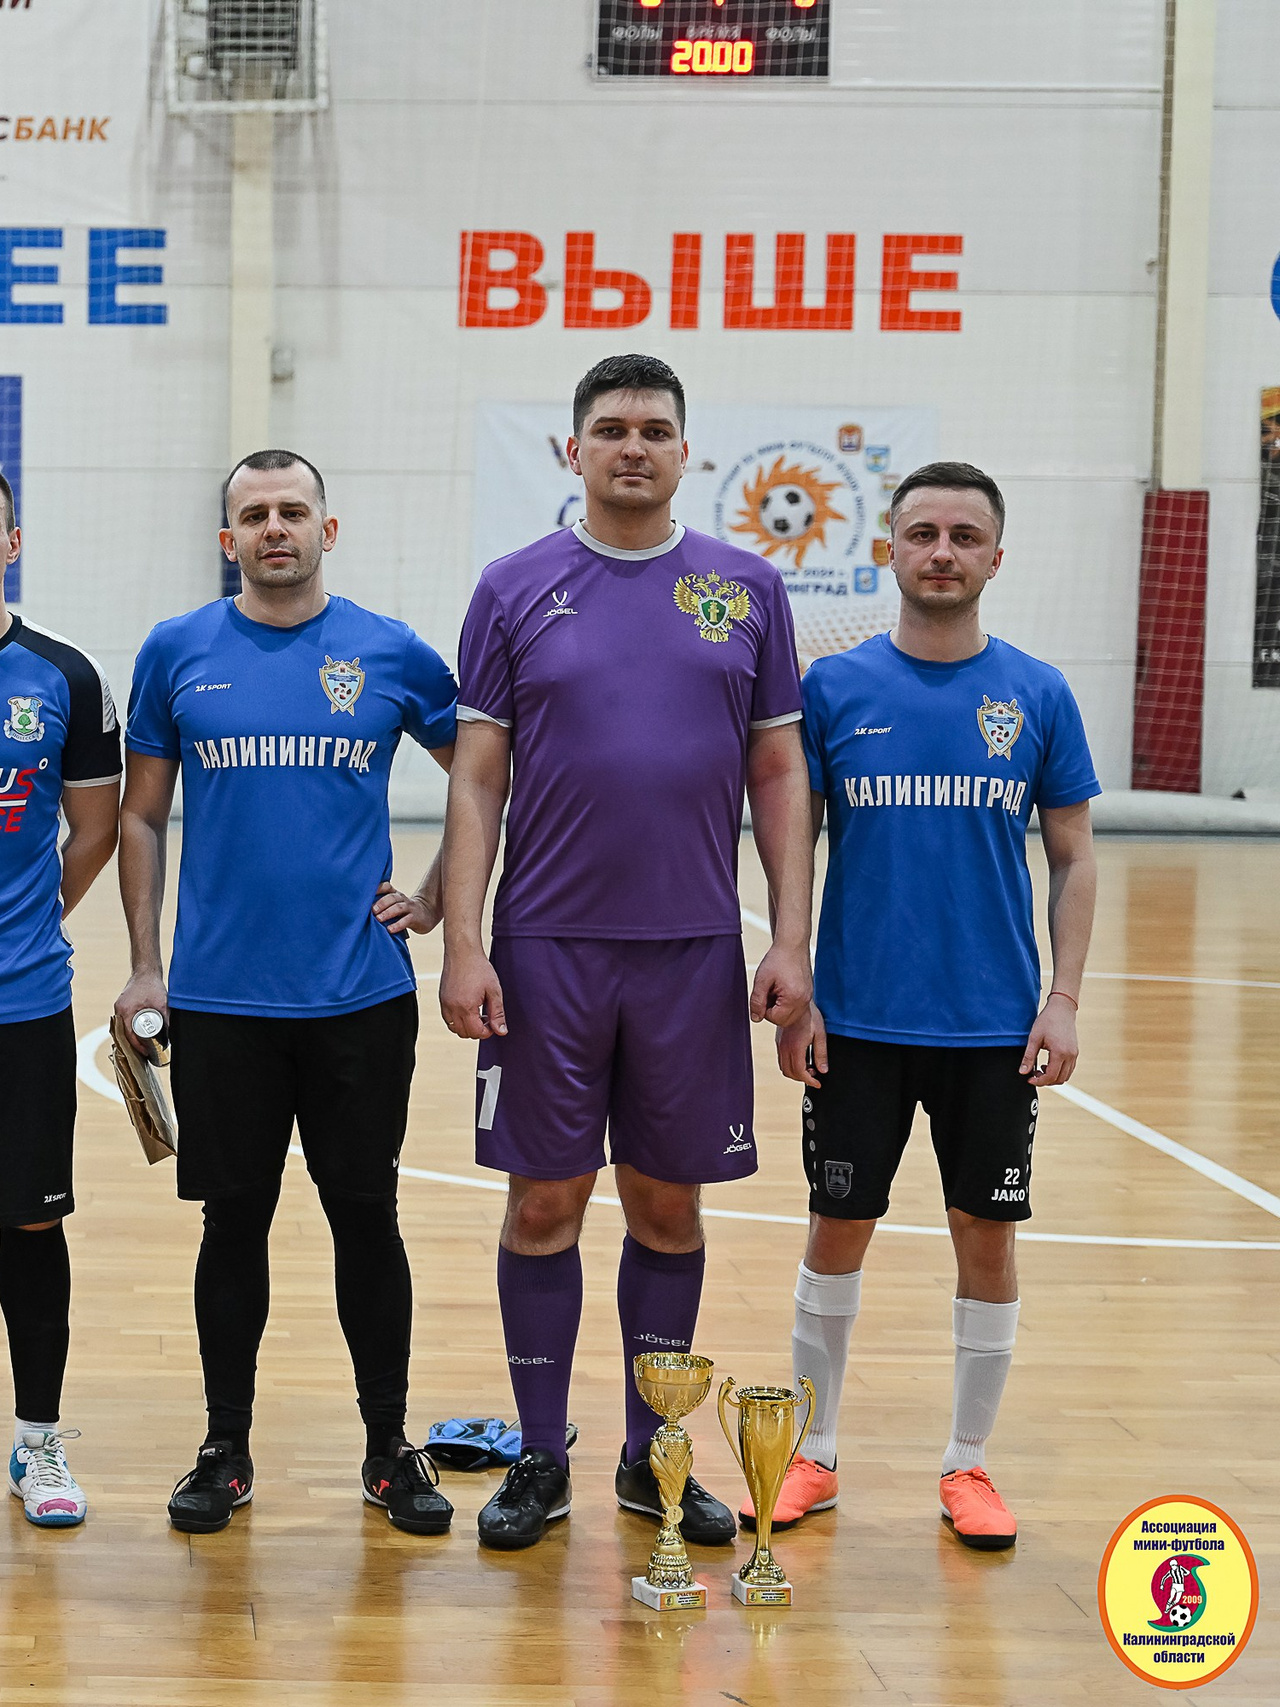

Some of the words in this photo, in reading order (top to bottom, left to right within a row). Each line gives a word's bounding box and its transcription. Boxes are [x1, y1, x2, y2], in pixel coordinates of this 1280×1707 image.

[457, 230, 965, 332] ВЫШЕ
[207, 683, 232, 691] SPORT
[868, 726, 892, 735] SPORT
[194, 736, 377, 773] КАЛИНИНГРАД
[844, 775, 1027, 816] КАЛИНИНГРАД
[476, 1064, 502, 1130] 1
[1004, 1168, 1020, 1185] 22
[991, 1188, 1026, 1201] JAKO
